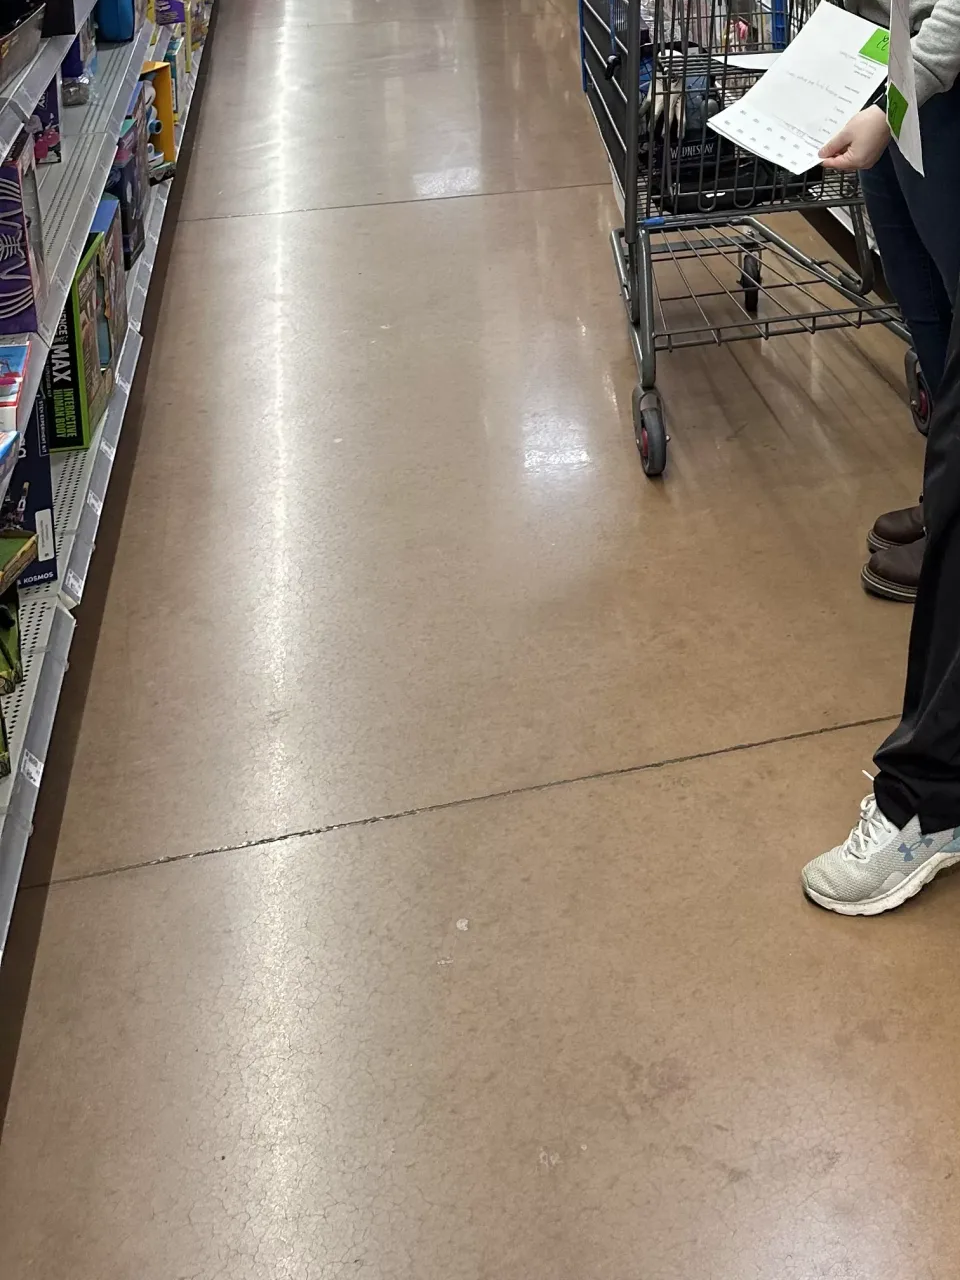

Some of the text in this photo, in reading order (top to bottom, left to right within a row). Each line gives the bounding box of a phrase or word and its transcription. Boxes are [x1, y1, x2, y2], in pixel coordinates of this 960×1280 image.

[669, 142, 715, 160] WDNESAY
[51, 343, 72, 383] MAX
[53, 389, 67, 438] HUMAN BODY
[63, 388, 78, 438] INTERACTIVE
[23, 570, 54, 586] KOSMOS
